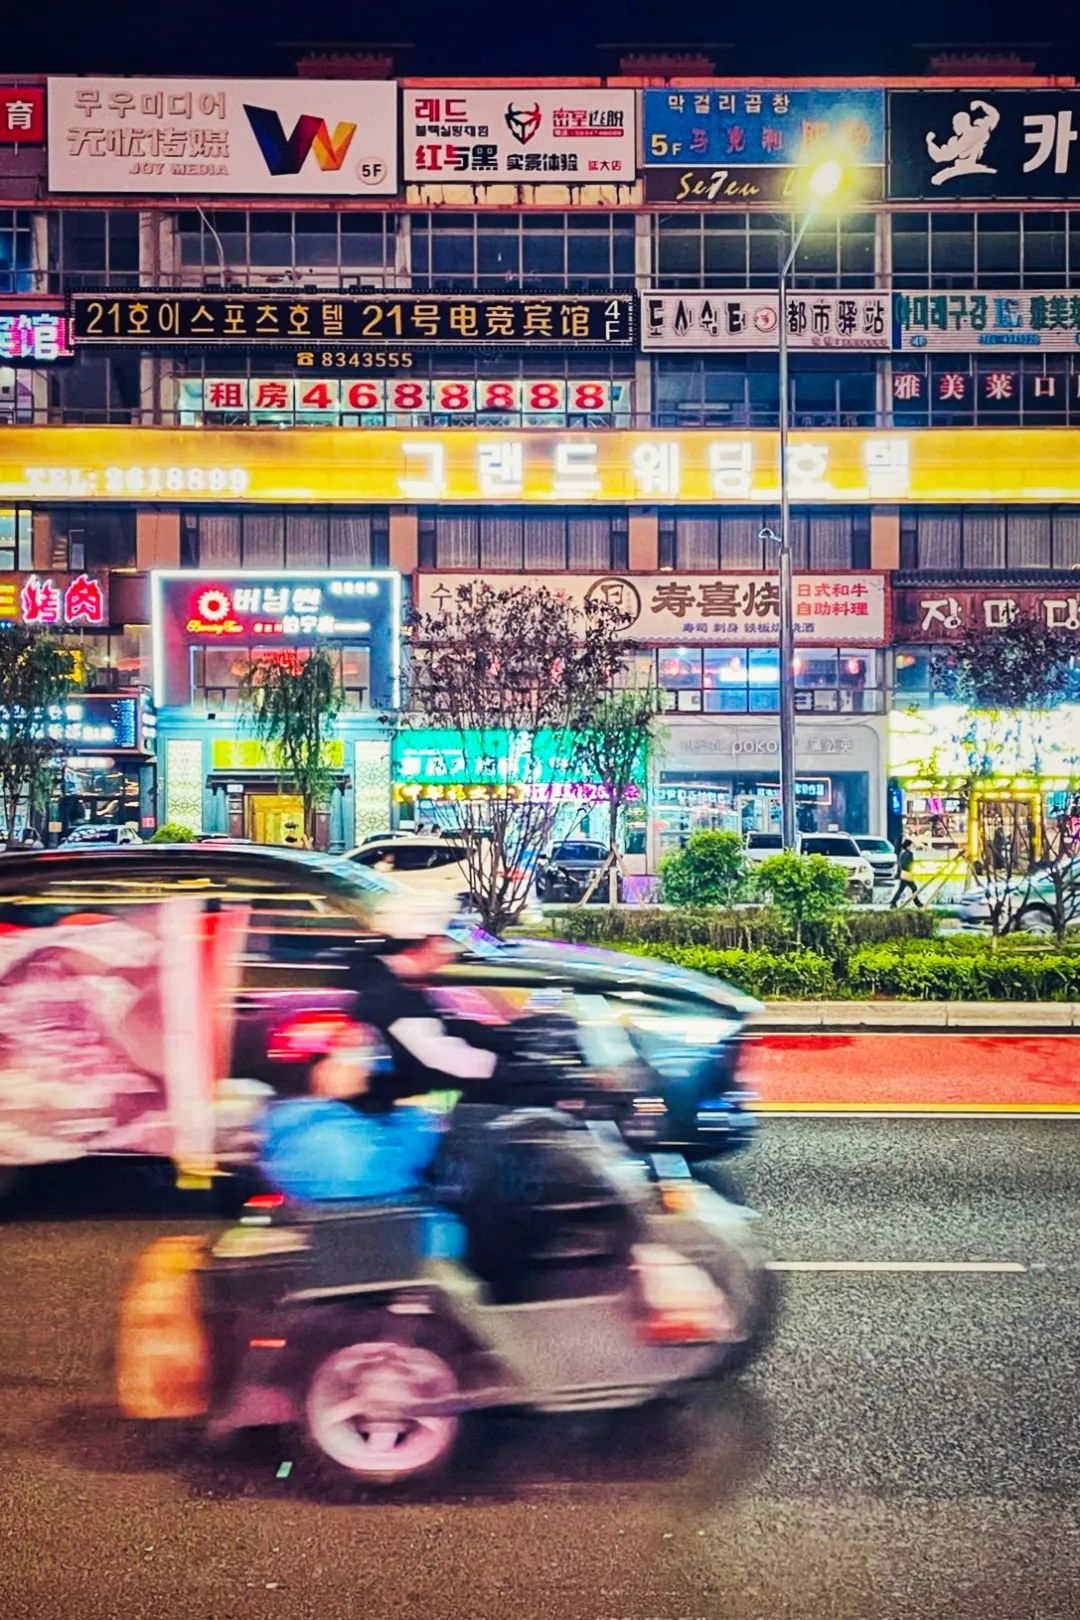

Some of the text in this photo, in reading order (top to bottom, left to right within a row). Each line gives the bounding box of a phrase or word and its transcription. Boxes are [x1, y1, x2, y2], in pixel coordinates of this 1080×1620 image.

[74, 90, 227, 119] 무우미디어
[415, 99, 468, 122] 레드
[668, 94, 790, 114] 막걸리곱창
[67, 126, 230, 158] 无忧传媒
[651, 133, 683, 156] 5F
[1023, 110, 1078, 174] 카
[129, 162, 230, 176] JOY MEDIA
[361, 164, 383, 177] 5F
[415, 144, 498, 171] 红与黑
[506, 153, 578, 171] 实景体验
[361, 303, 591, 337] 21号电竞宾馆
[648, 299, 746, 336] 도시쉼터
[787, 299, 885, 334] 都市驿站
[322, 352, 413, 367] 8343555
[894, 374, 1080, 400] 雅美莱口
[398, 438, 910, 499] 그랜드웨딩호텔
[21, 574, 104, 623] 烤肉
[651, 581, 781, 618] 寿喜烧
[797, 583, 869, 598] 日式和牛
[797, 602, 869, 617] 自助料理
